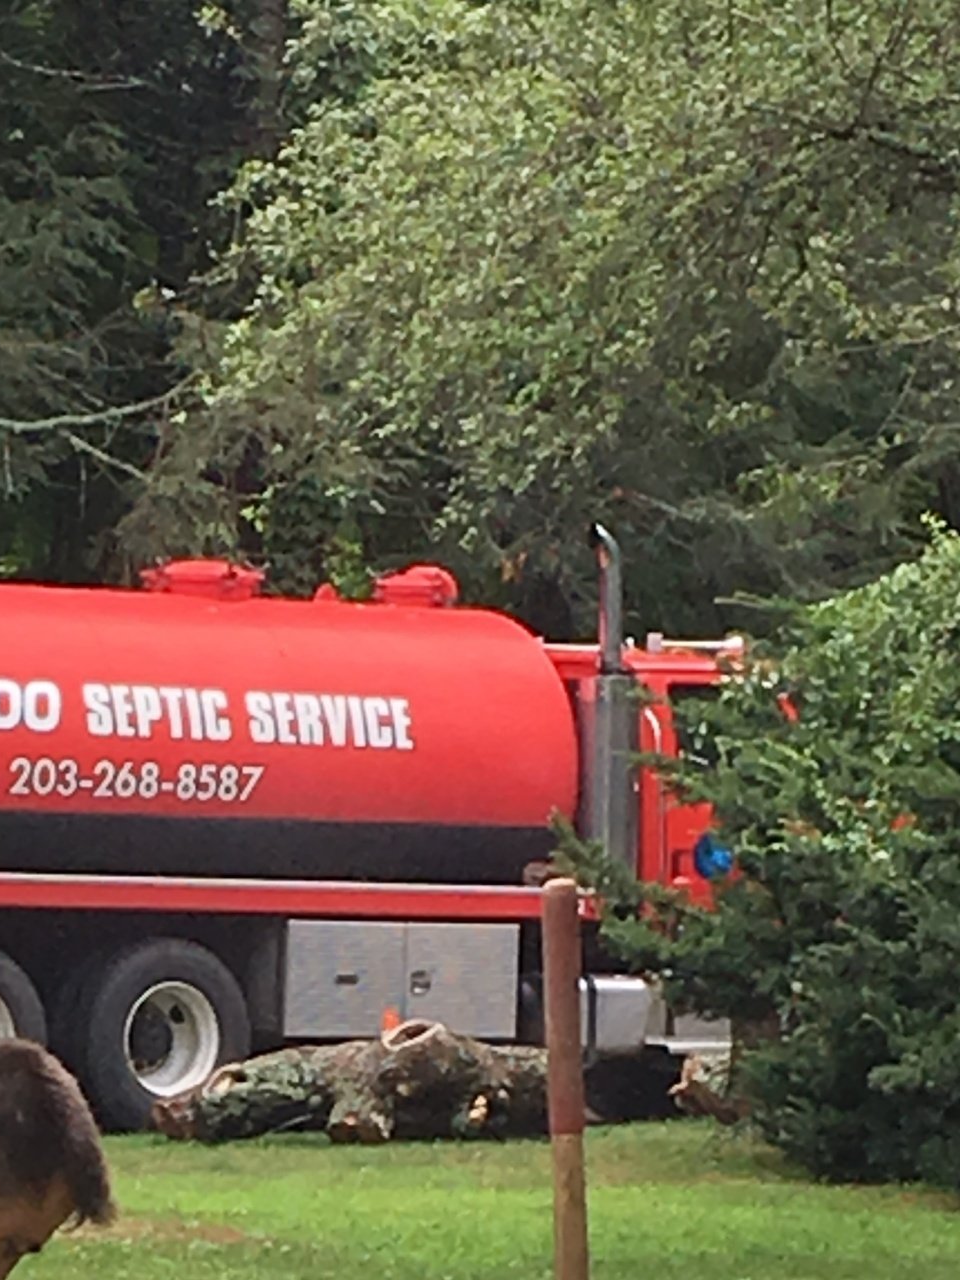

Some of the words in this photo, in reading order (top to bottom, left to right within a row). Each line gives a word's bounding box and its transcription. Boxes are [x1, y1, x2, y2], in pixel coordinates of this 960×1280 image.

[83, 683, 231, 741] SEPTIC
[247, 691, 413, 750] SERVICE
[8, 757, 264, 801] 203-268-8587
